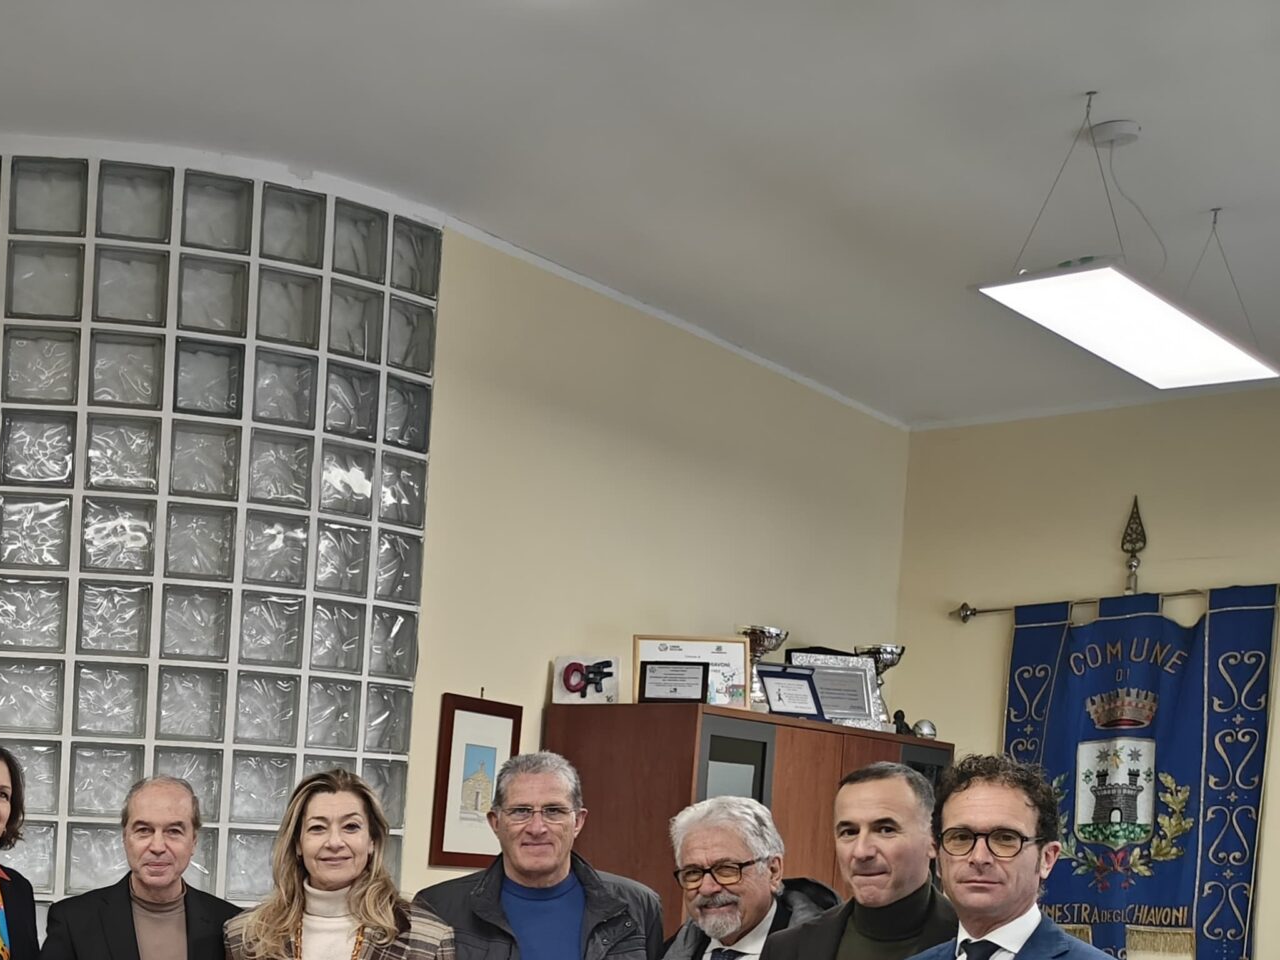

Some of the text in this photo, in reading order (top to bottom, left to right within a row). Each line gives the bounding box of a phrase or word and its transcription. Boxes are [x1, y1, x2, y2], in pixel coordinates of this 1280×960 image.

[1069, 637, 1188, 676] COMUNE
[1115, 668, 1130, 682] DI
[1039, 903, 1188, 926] INESTRA DEGL CHIAVONI
